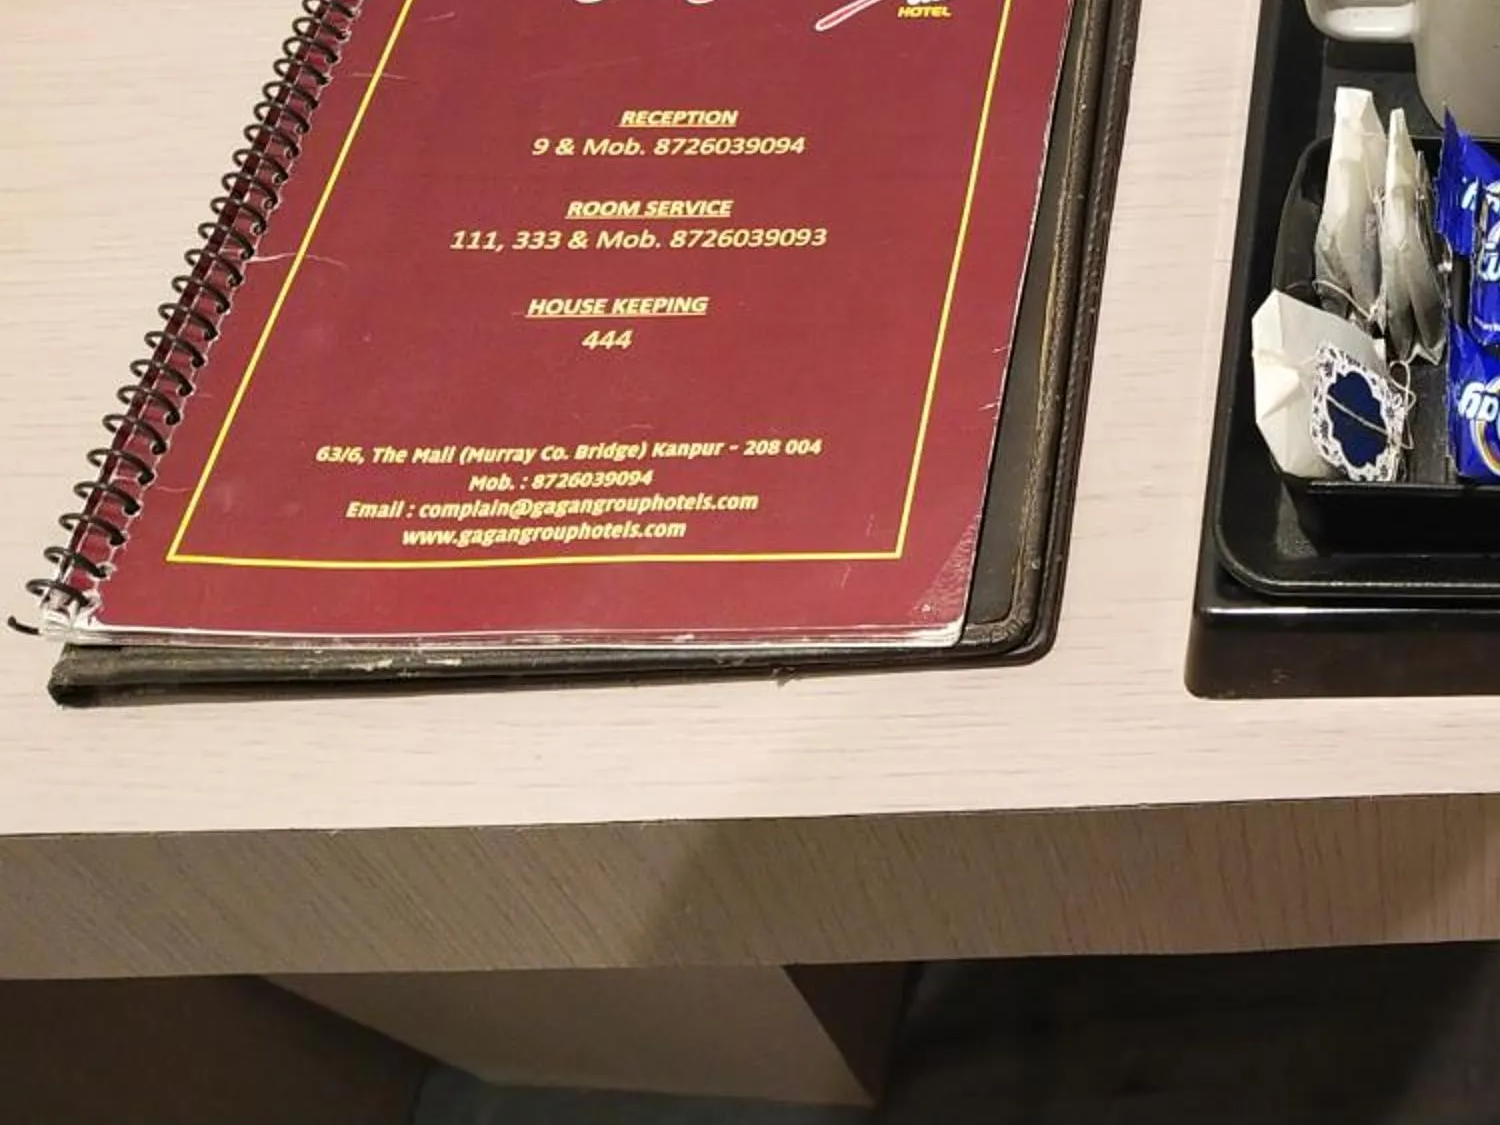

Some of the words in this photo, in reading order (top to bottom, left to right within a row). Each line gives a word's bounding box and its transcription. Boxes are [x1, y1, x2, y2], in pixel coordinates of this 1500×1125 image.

[897, 6, 952, 18] HOTEL
[619, 109, 739, 128] RECEPTION
[531, 137, 550, 156] 9
[554, 137, 575, 156] &
[582, 136, 646, 156] Mob.
[653, 136, 806, 156] 8726039094
[564, 200, 640, 220] ROOM
[643, 199, 735, 218] SERVICE
[449, 230, 505, 252] 111,
[511, 230, 563, 250] 333
[567, 230, 589, 250] &
[595, 228, 662, 249] Mob.
[669, 228, 828, 249] 8726039093
[525, 298, 608, 318] HOUSE
[609, 296, 710, 316] KEEPING
[581, 329, 634, 350] 444
[315, 446, 365, 464] 63/6,
[373, 447, 408, 463] The
[411, 446, 457, 464] Mall
[459, 446, 537, 465] (Murray
[540, 445, 570, 462] Co.
[574, 441, 648, 461] Bridge)
[651, 442, 725, 459] Kanpur
[743, 439, 781, 456] 208
[784, 439, 823, 456] 004
[468, 475, 516, 492] Mob.
[531, 470, 654, 490] 8726039094
[345, 500, 405, 518] Email
[418, 492, 759, 521] complain@gagangrouphotels.com
[402, 520, 687, 548] www.gagangrouphotels.com
